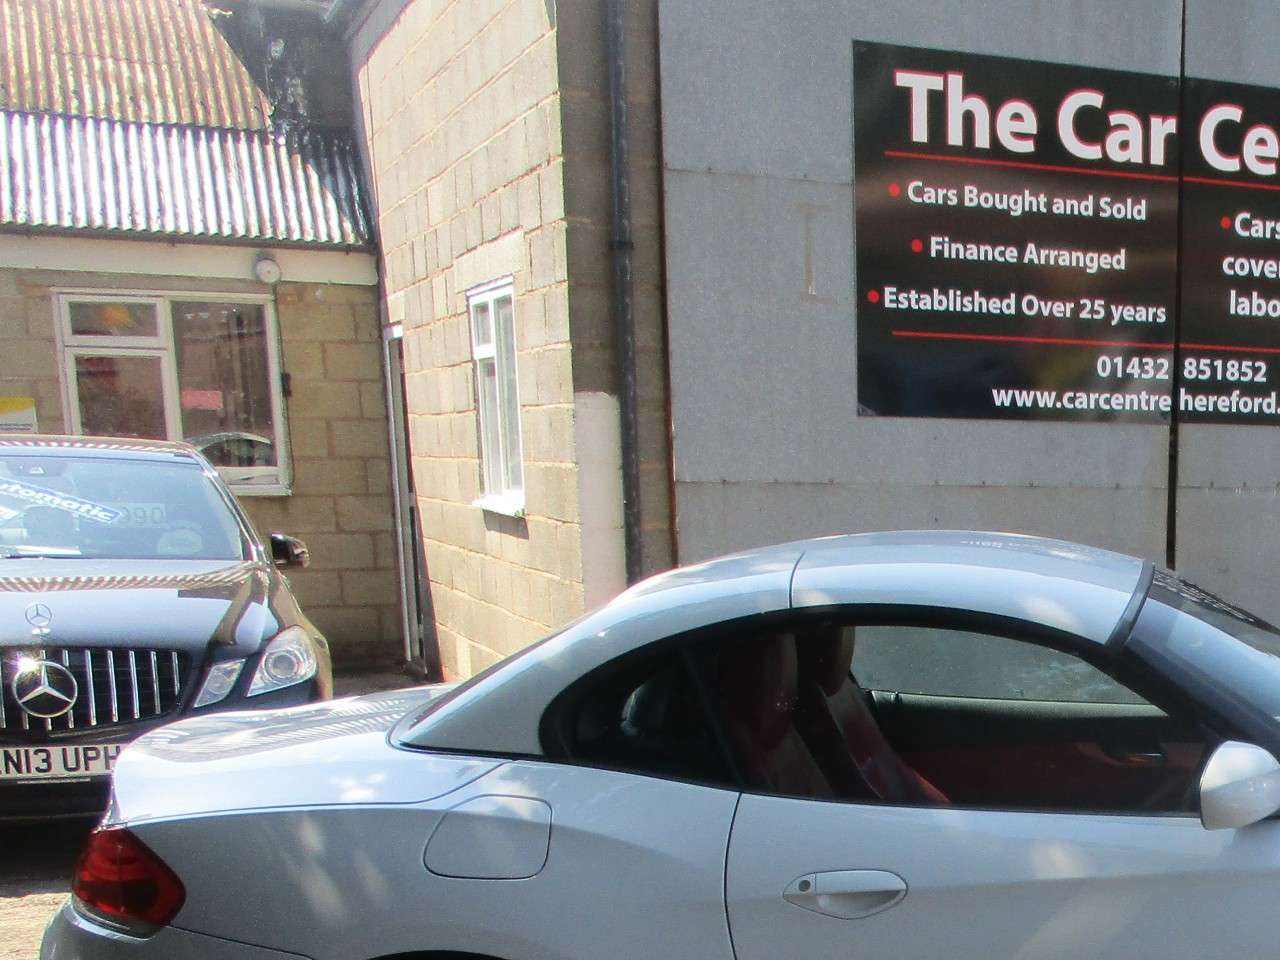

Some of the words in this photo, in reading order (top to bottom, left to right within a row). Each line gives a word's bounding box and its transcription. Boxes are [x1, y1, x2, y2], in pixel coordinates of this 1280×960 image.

[893, 69, 1039, 154] The
[1056, 88, 1177, 167] Car
[907, 180, 959, 206] Cars
[963, 184, 1048, 217] Bought
[1051, 194, 1094, 217] and
[1099, 196, 1147, 221] Sold
[930, 235, 1018, 263] Finance
[1022, 242, 1126, 274] Arranged
[884, 286, 1016, 315] Established
[1021, 294, 1075, 318] Over
[1079, 298, 1105, 320] 25
[1110, 304, 1167, 326] years
[1096, 354, 1170, 380] 01432
[1183, 357, 1267, 383] 851852
[0, 749, 53, 775] N13
[62, 746, 120, 772] UPH
